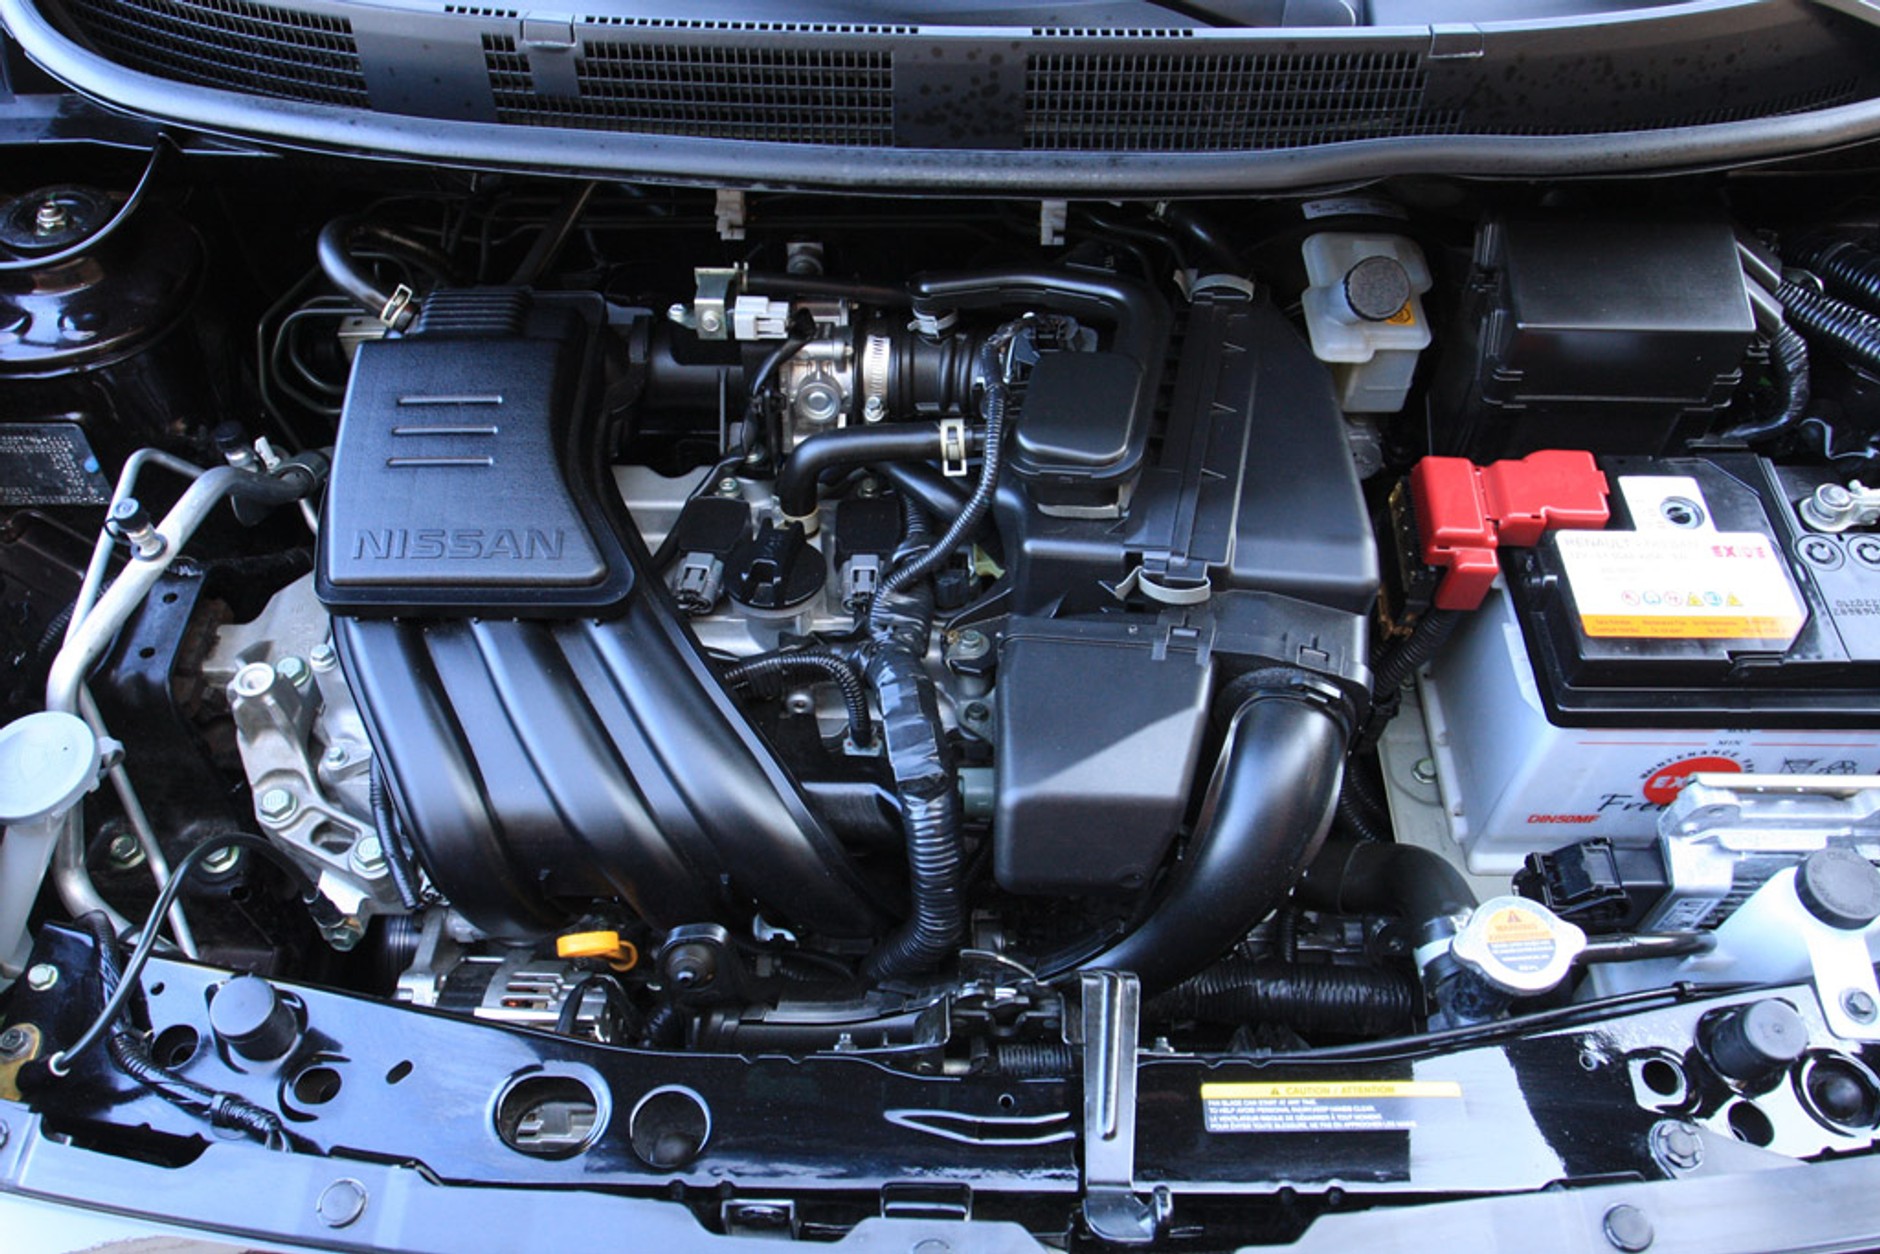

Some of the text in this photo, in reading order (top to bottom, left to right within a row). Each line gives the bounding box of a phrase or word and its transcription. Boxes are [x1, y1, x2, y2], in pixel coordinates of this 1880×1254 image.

[353, 528, 565, 560] NISSAN
[1711, 545, 1766, 559] EXIDE
[1285, 1086, 1330, 1095] CAUTION
[1341, 1086, 1395, 1094] ATTENTION
